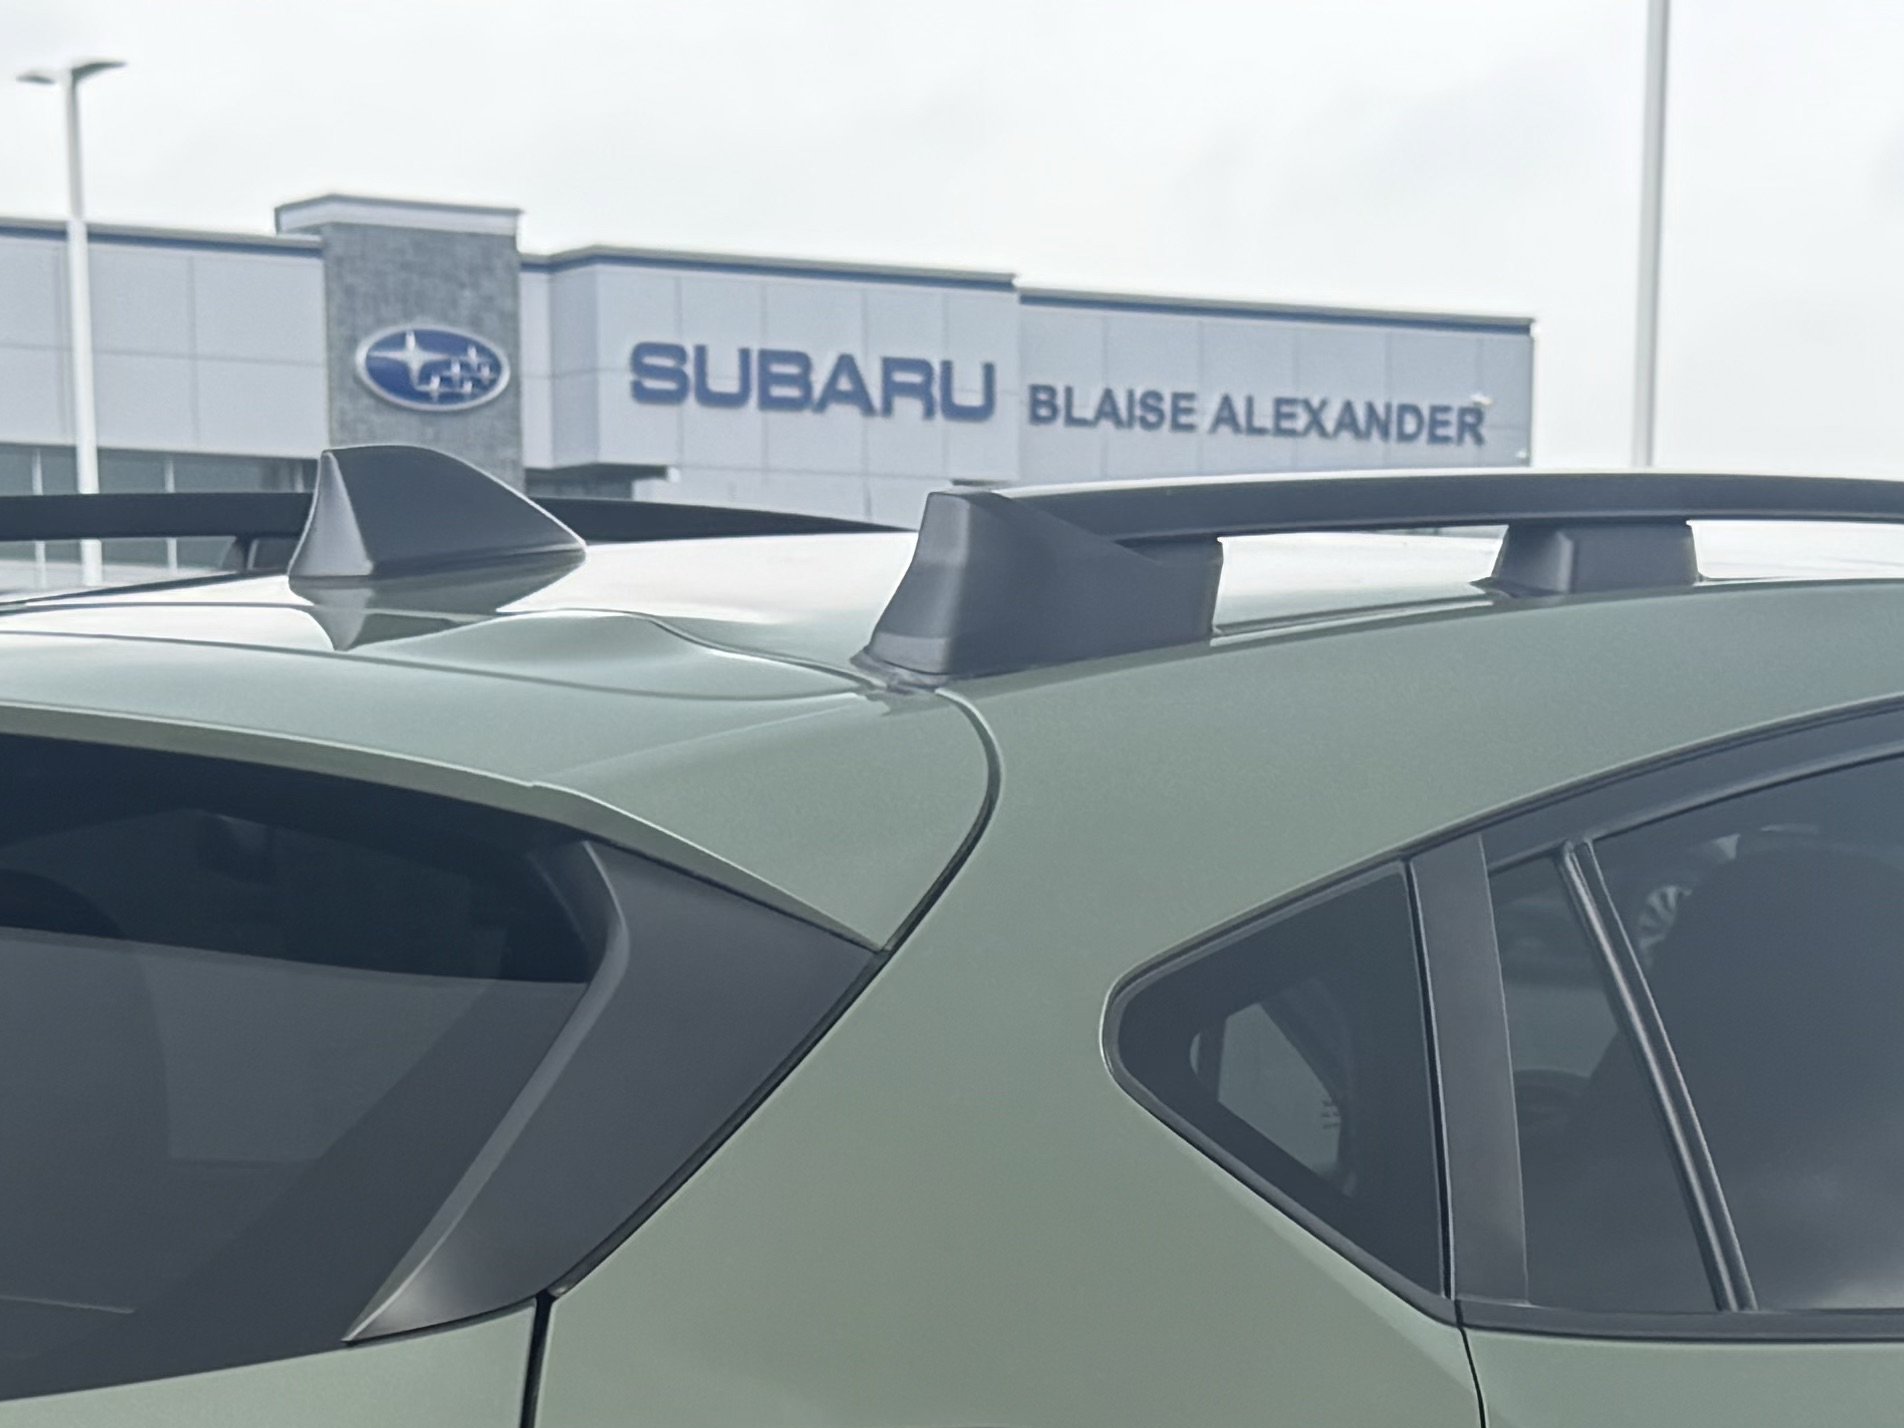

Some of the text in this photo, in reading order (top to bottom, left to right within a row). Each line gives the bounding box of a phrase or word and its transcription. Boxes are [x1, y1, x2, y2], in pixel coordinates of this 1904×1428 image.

[629, 342, 996, 422] SUBARU
[1027, 384, 1486, 446] BLAISE ALEXANDER
